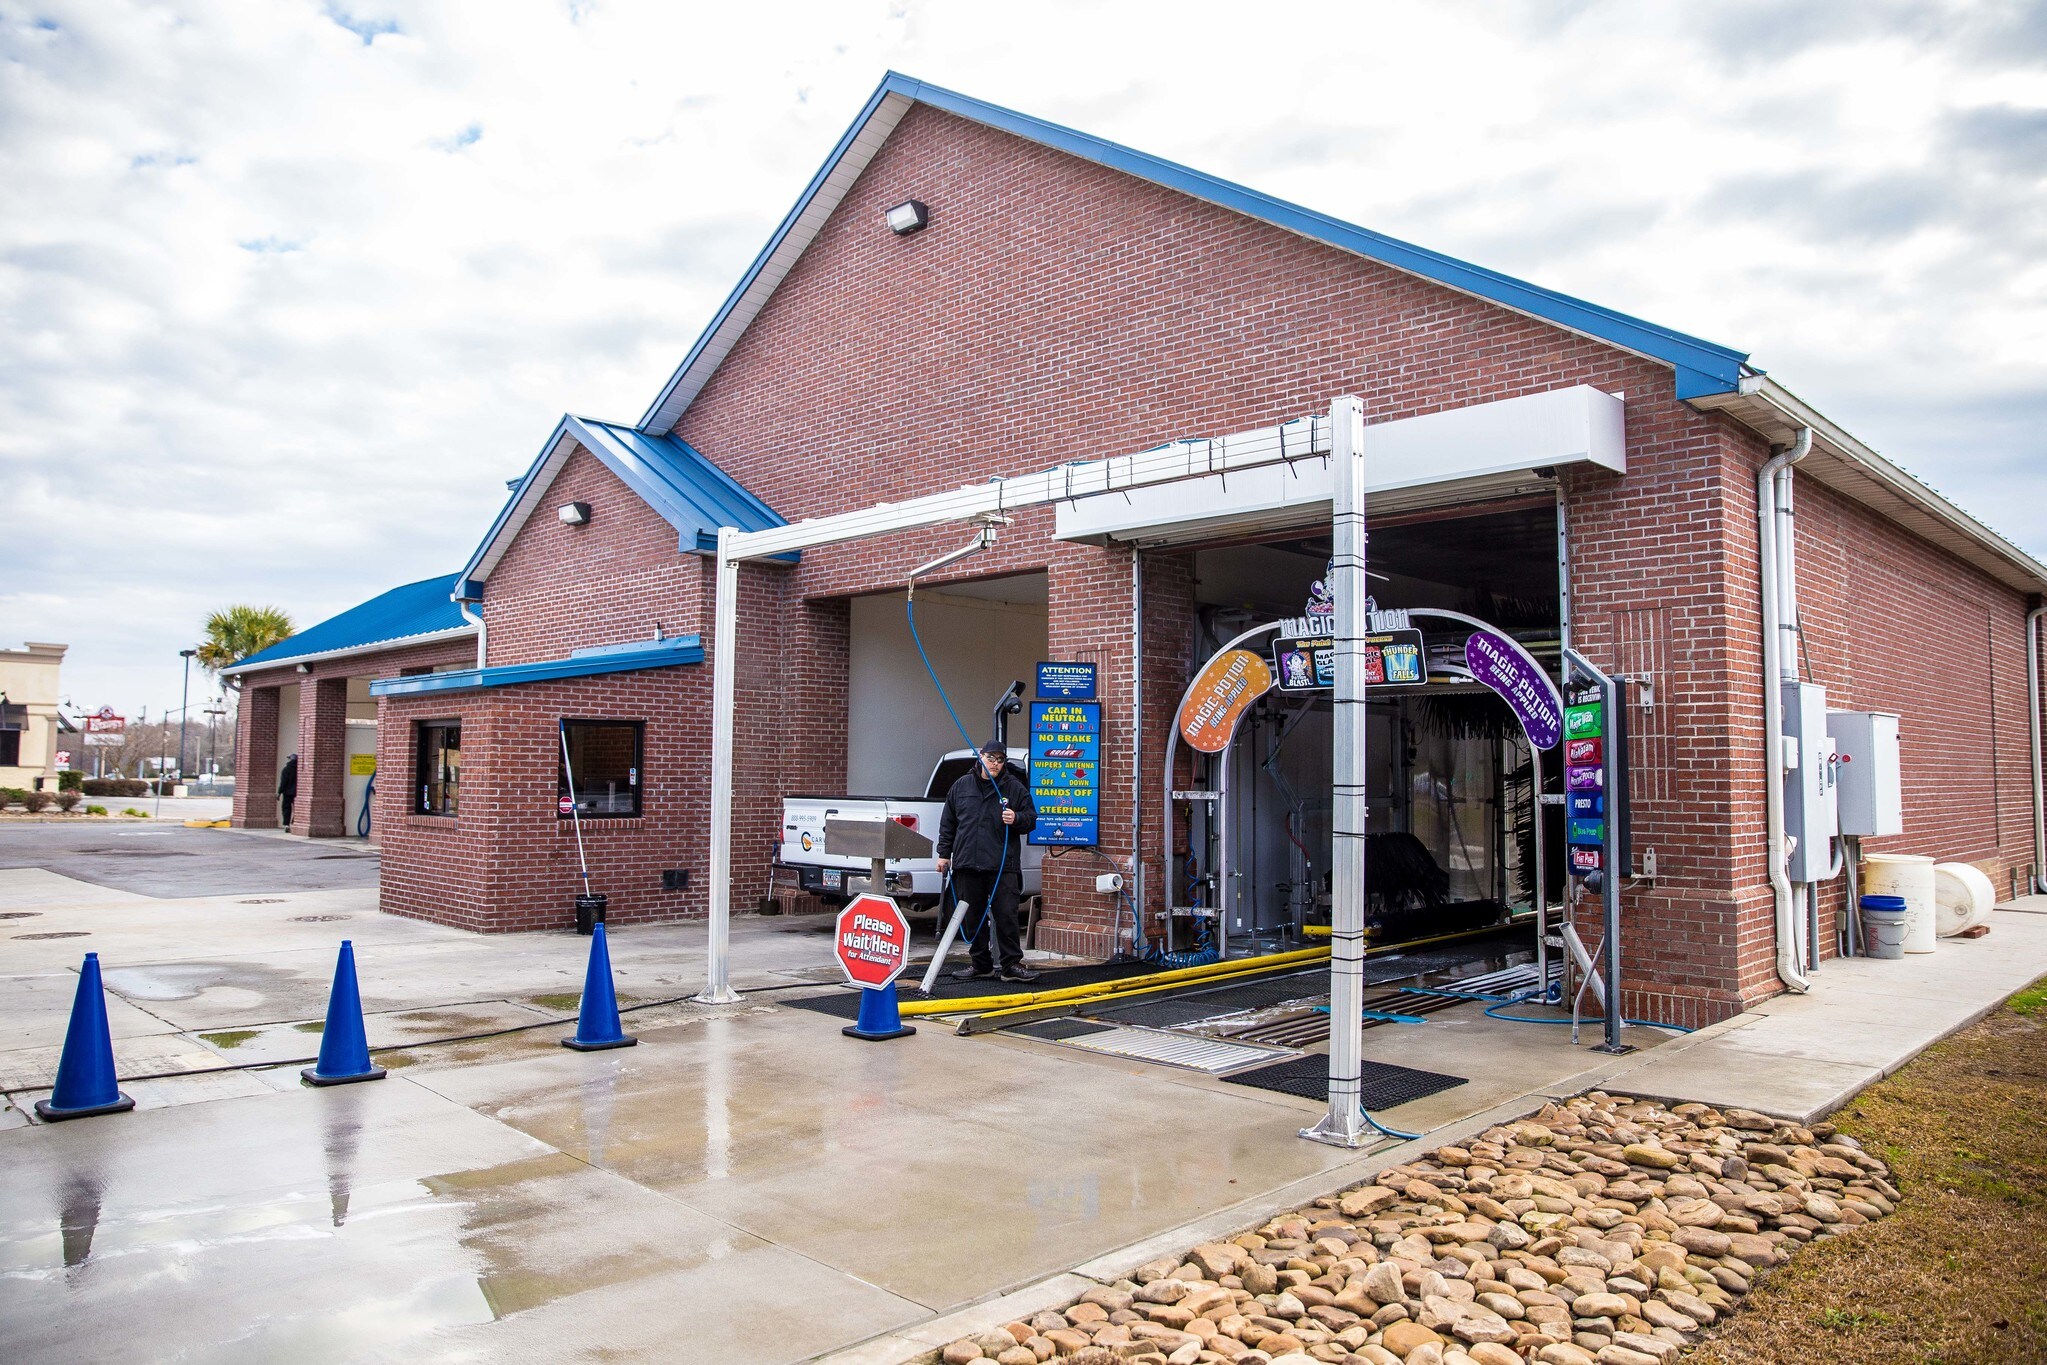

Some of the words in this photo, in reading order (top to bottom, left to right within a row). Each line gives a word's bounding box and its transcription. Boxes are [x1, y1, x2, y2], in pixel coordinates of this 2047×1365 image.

[1316, 651, 1334, 660] MAG
[1381, 646, 1418, 657] THUNDER
[1041, 666, 1092, 674] ATTENTION
[1393, 669, 1415, 679] FALLS
[1477, 638, 1519, 680] MAGIC
[1518, 677, 1557, 731] POTION
[1185, 695, 1219, 737] MAGIC
[1213, 654, 1250, 698] POTION
[1489, 664, 1513, 687] BEING
[1511, 686, 1539, 720] APPLIED
[1208, 704, 1228, 729] BEING
[1224, 676, 1249, 707] APPLIED
[1047, 706, 1067, 714] CAR
[1071, 707, 1082, 715] IN
[1041, 714, 1087, 722] NEUTRAL
[1038, 734, 1054, 742] NO
[1057, 734, 1092, 742] BRAKE
[1035, 788, 1071, 796] HANDS
[1074, 789, 1092, 797] OFF
[1574, 798, 1591, 809] PRESTO
[1039, 806, 1088, 814] STEERING
[853, 914, 894, 937] Please
[843, 932, 870, 950] Wait
[872, 934, 900, 956] Here
[847, 950, 858, 958] for
[859, 952, 892, 965] Attendant
